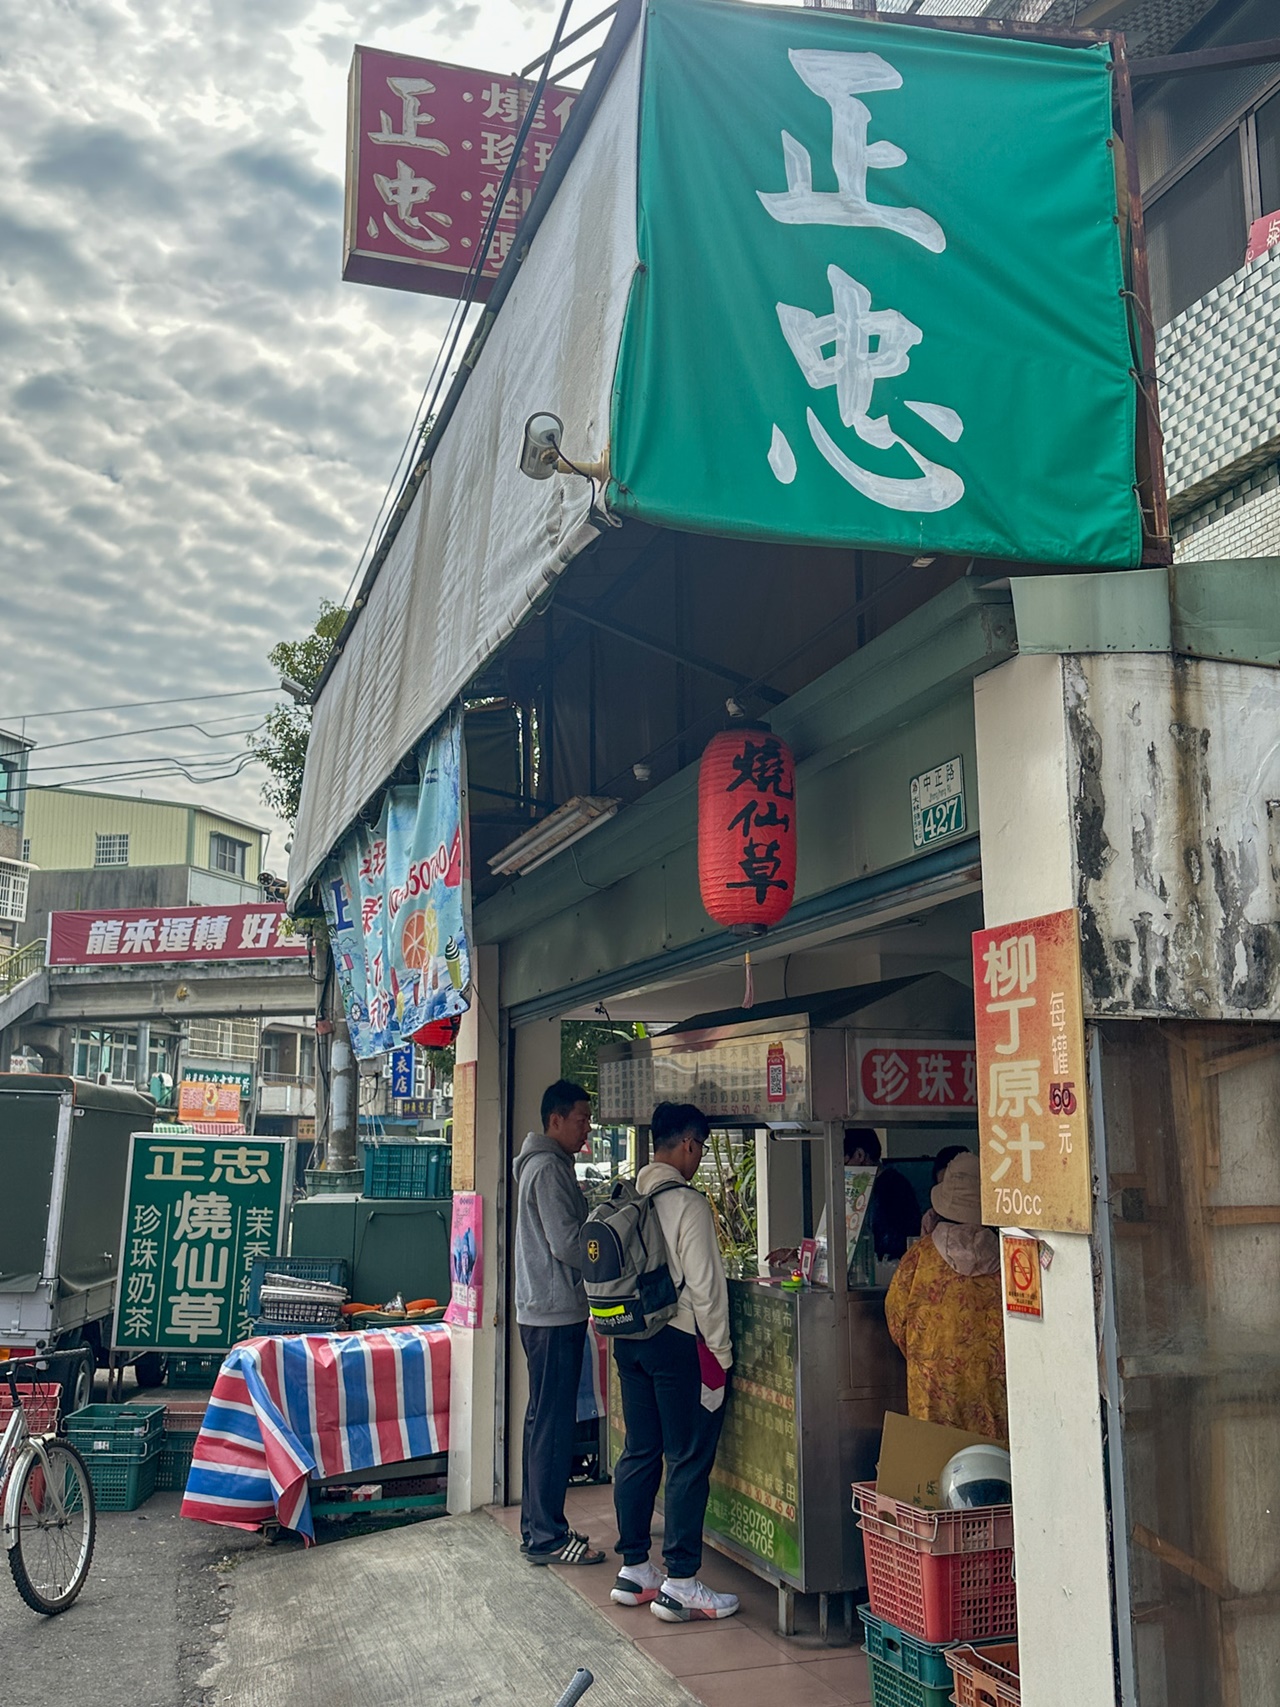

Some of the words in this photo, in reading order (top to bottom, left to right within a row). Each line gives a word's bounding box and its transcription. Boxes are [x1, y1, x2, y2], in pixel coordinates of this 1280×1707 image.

[367, 76, 450, 254] 正忠
[756, 48, 965, 513] 正忠
[923, 763, 955, 793] 中正路
[924, 797, 959, 839] 427
[726, 737, 794, 906] 燒仙草
[86, 915, 232, 955] 龍來運轉
[983, 935, 1045, 1185] 柳丁原汁
[1049, 991, 1071, 1076] 每罐
[145, 1145, 271, 1185] 正忠
[1058, 1124, 1073, 1155] 元
[994, 1188, 1042, 1216] 750cc
[124, 1204, 162, 1339] 珍珠奶茶
[165, 1190, 233, 1344] 燒仙草
[772, 1308, 783, 1390] 燒仙草
[782, 1310, 794, 1395] 布丁奶茶
[785, 1419, 795, 1502] 阿華田
[729, 1516, 775, 1559] 2654705
[730, 1498, 775, 1540] 2650780
